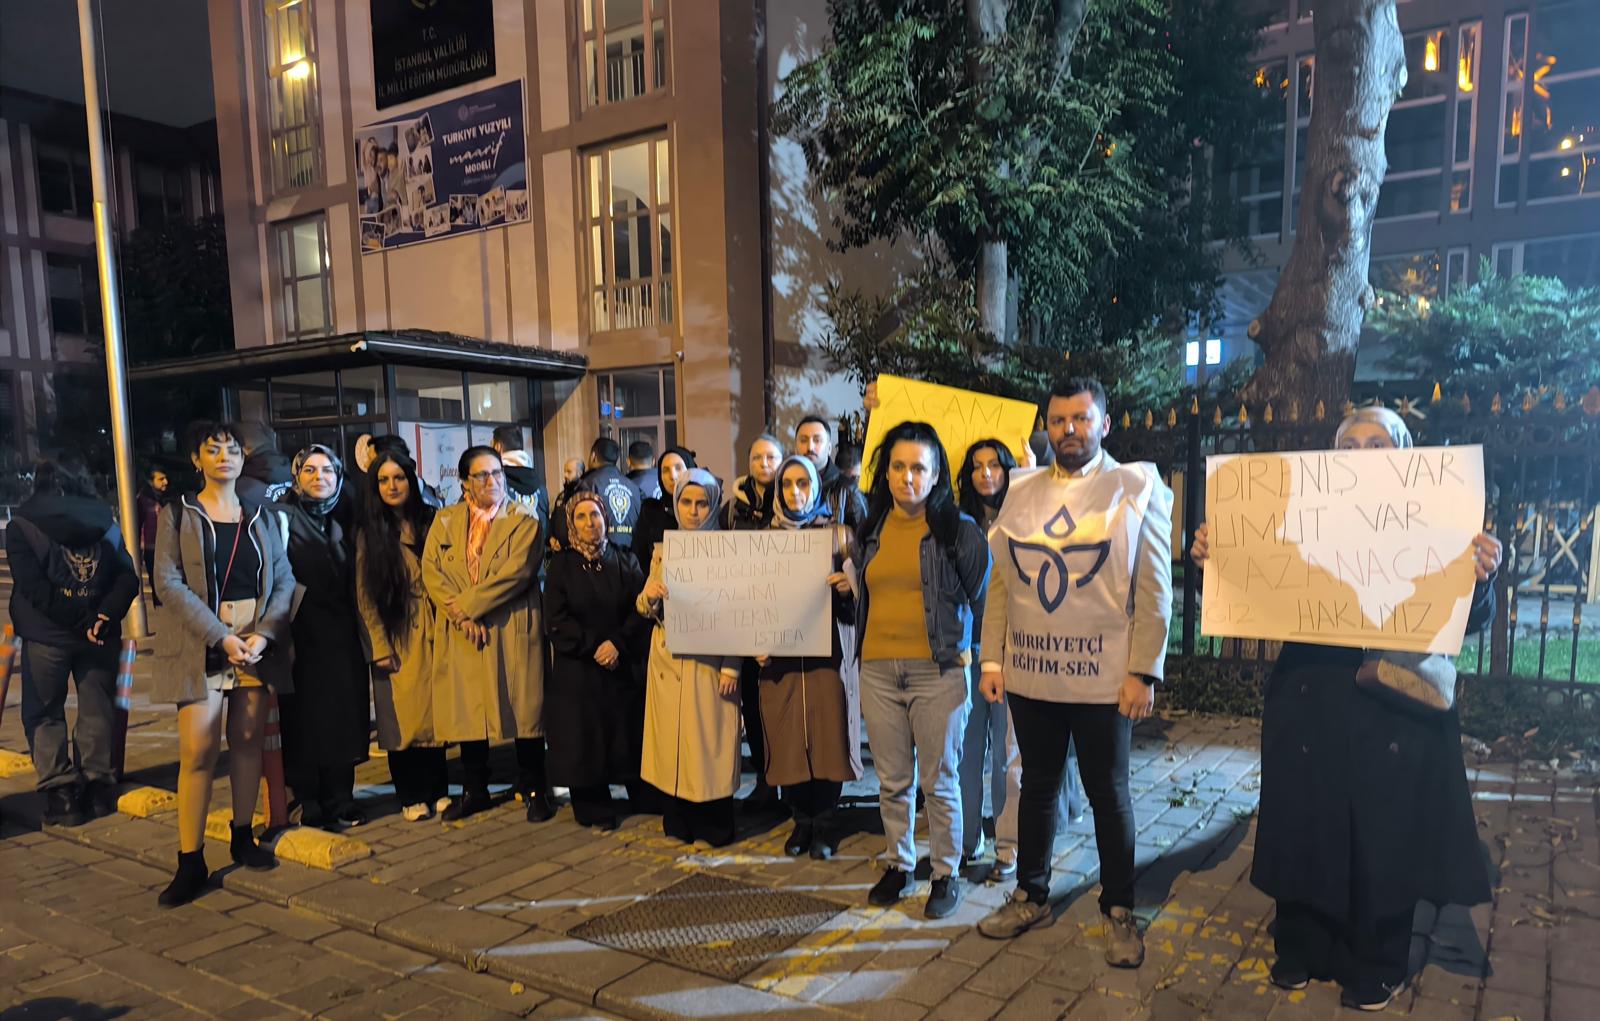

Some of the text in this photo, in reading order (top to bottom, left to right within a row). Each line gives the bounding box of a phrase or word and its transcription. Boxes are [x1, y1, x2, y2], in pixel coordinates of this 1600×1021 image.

[1387, 451, 1465, 488] VAR
[1214, 501, 1428, 548] UMUT VAR
[1297, 600, 1435, 634] HAKLIYIZ
[1012, 629, 1103, 656] HÜRRİYETÇİ
[1012, 652, 1100, 676] EĞİTİM-SEN
